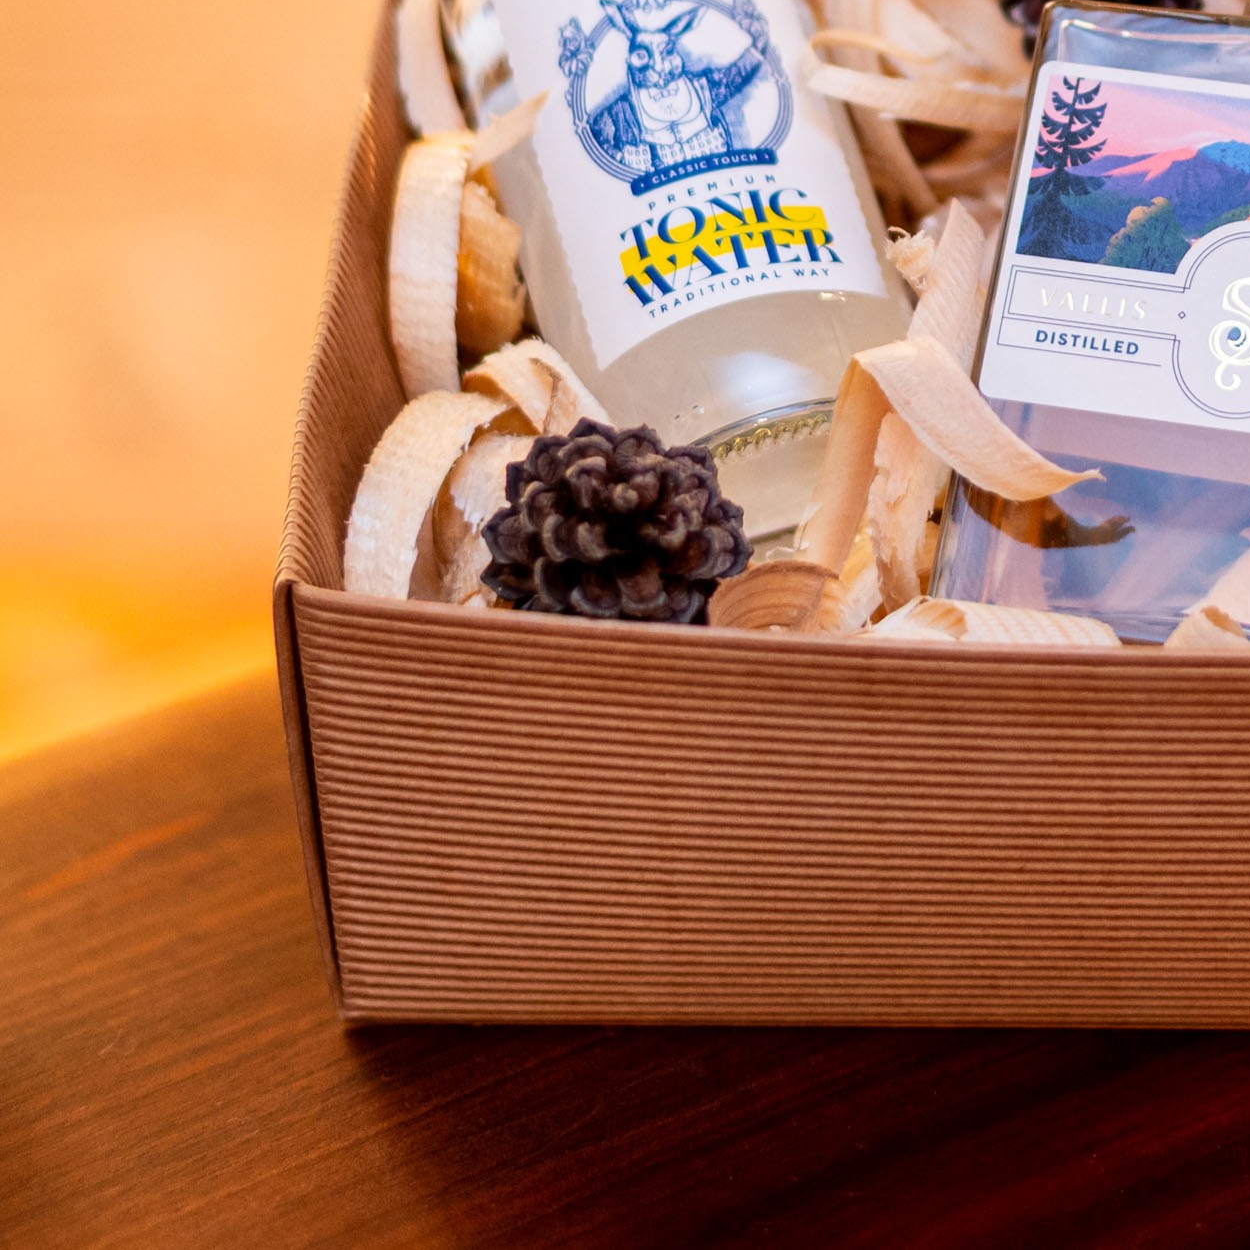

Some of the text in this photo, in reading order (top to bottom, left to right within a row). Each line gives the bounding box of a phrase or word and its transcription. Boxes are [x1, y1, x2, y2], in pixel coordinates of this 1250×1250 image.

[652, 153, 758, 184] CLASSIC TOUCH
[648, 174, 776, 211] PREMIUM
[620, 188, 817, 261] TONIC
[622, 227, 843, 308] WATER
[649, 267, 831, 318] TRADITIONAL WAY
[1039, 286, 1147, 320] VALLIS
[1035, 329, 1139, 355] DISTILLED
